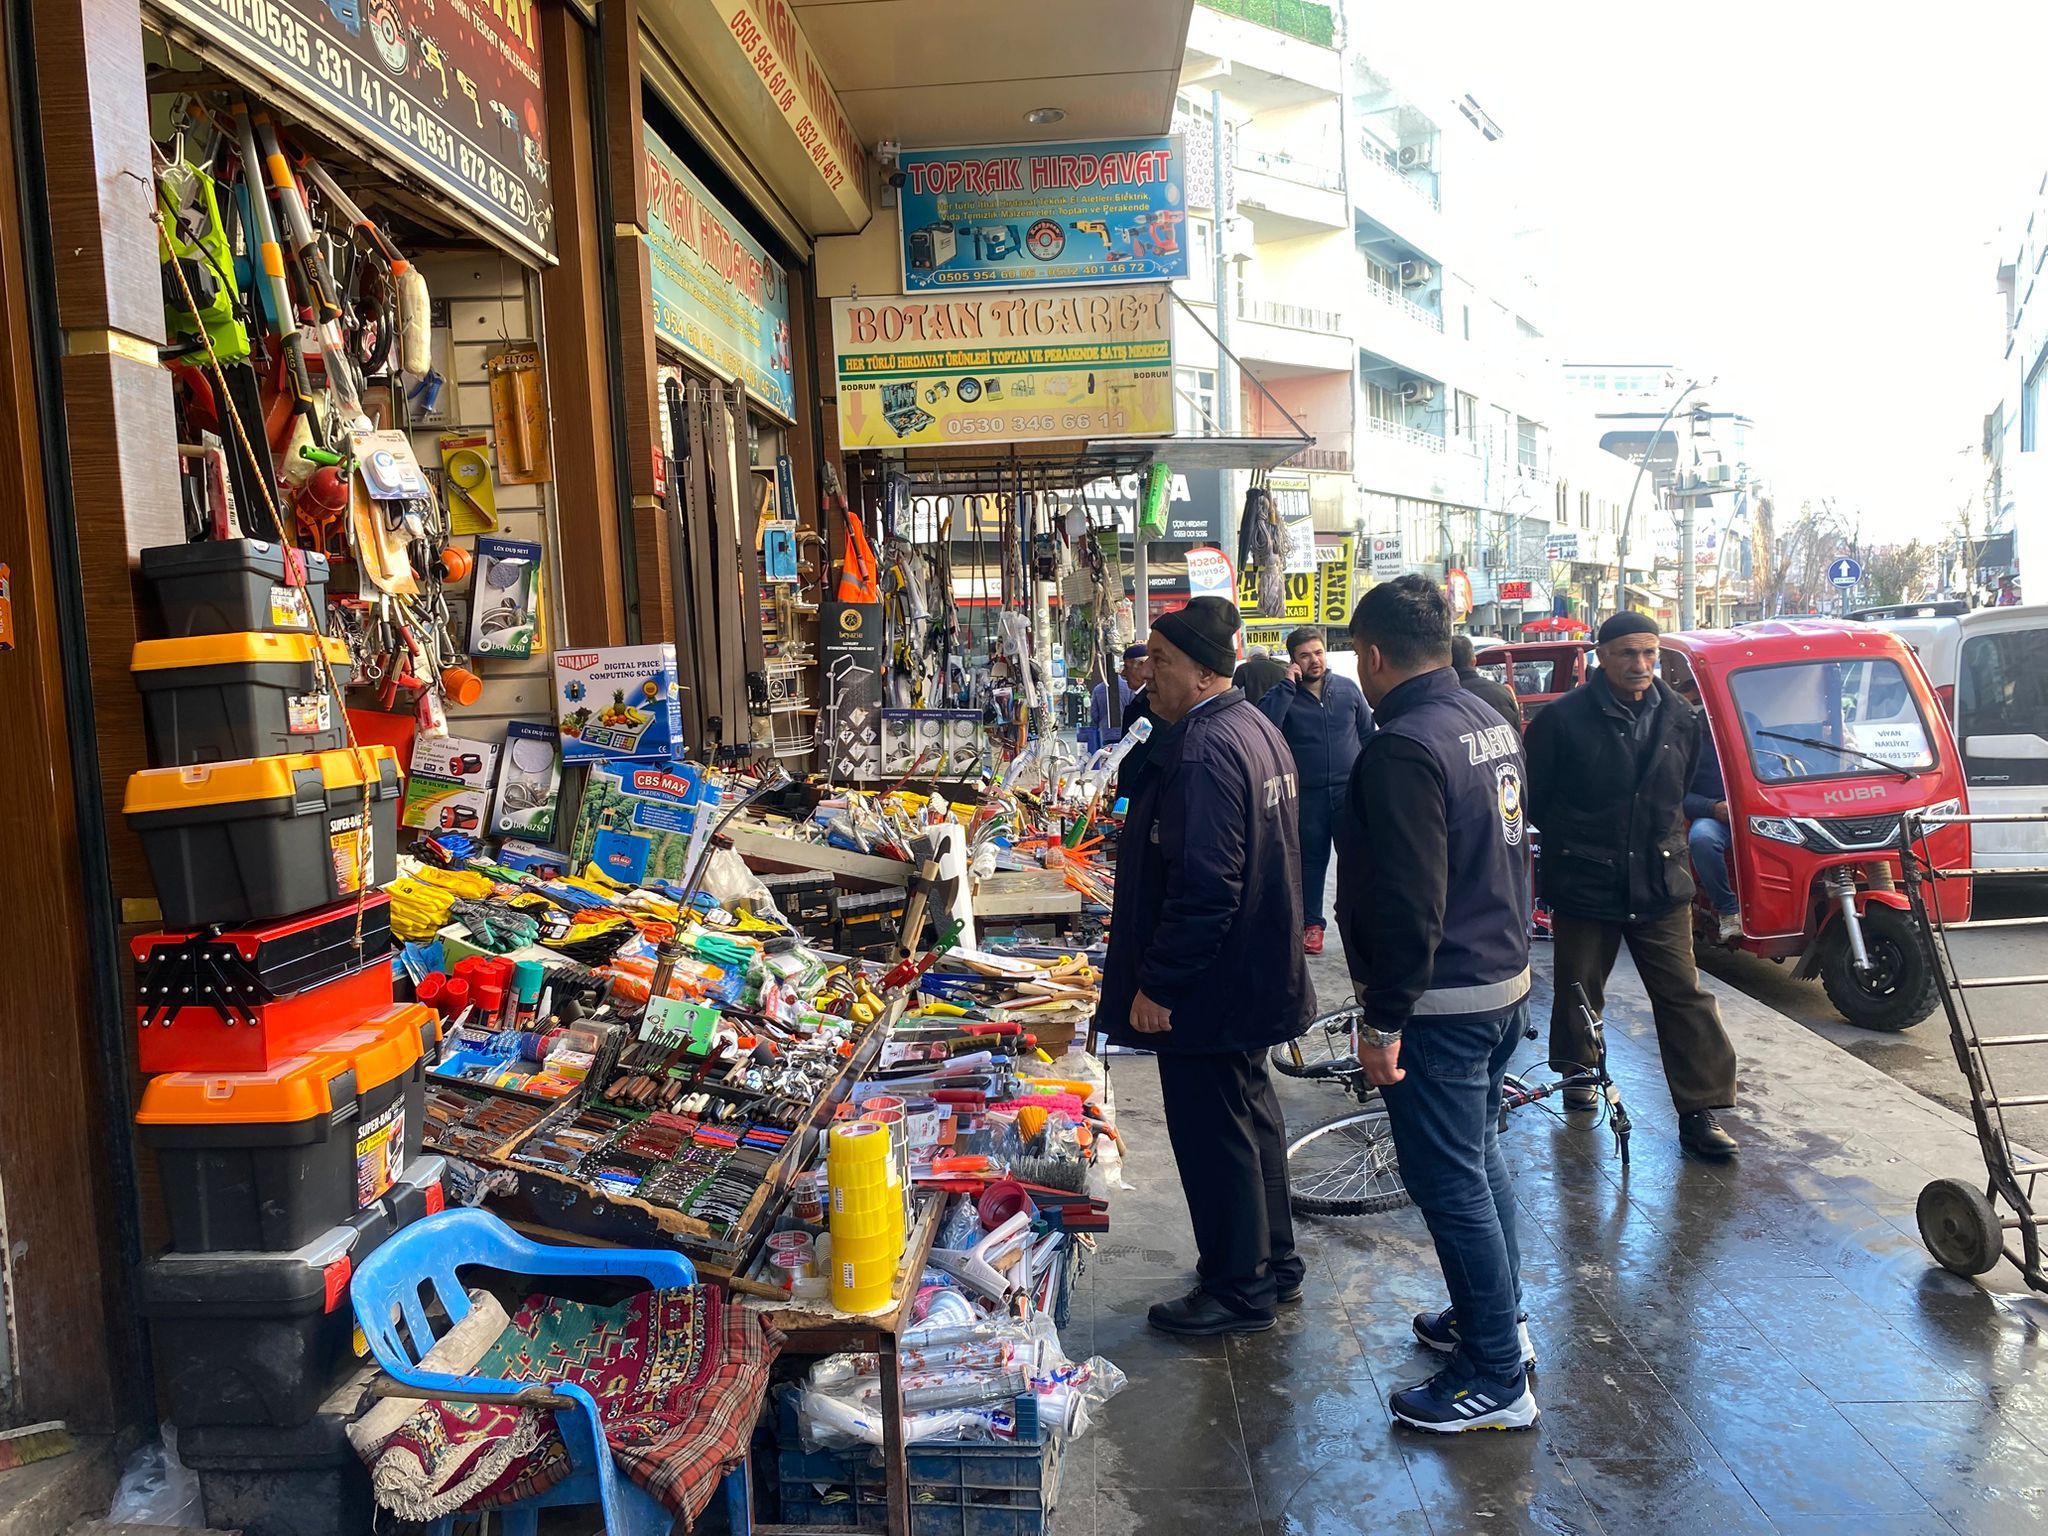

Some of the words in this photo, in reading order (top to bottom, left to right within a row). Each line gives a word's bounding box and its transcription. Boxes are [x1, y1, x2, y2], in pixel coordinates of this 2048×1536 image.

[730, 9, 762, 53] 0505
[753, 45, 777, 79] 954
[769, 72, 786, 96] 60
[779, 88, 796, 113] 06
[315, 38, 354, 98] 331
[360, 69, 383, 118] 41
[459, 143, 487, 191] 872
[489, 166, 507, 204] 83
[509, 180, 525, 218] 25
[795, 115, 818, 150] 0532
[812, 142, 828, 167] 401
[822, 160, 837, 179] 46
[907, 155, 1024, 197] TOPRAK
[1030, 150, 1172, 195] HIRDAVAT
[829, 170, 844, 191] 72
[644, 146, 698, 256] PRAK
[1058, 206, 1088, 216] Toptan
[1090, 206, 1101, 214] ve
[1103, 203, 1151, 214] Perakende
[938, 272, 969, 282] 0505
[973, 271, 996, 281] 954
[1000, 270, 1016, 279] 60
[1082, 265, 1105, 275] 401
[1109, 263, 1126, 273] 46
[1129, 262, 1145, 272] 72
[664, 306, 686, 340] 954
[686, 321, 701, 351] 60
[847, 301, 985, 345] BOTAN
[991, 292, 1165, 339] TİCARET
[504, 354, 534, 365] ELTOS
[845, 358, 865, 372] HER
[866, 354, 896, 371] TÜRLÜ
[897, 355, 944, 370] HIRDAVAT
[945, 350, 991, 367] ÜRÜNLERİ
[992, 348, 1029, 365] TOPTAN
[1030, 348, 1044, 364] VE
[1044, 346, 1099, 363] PERAKENDE
[1100, 345, 1127, 362] SATIŞ
[1128, 341, 1169, 359] MERKEZİ
[1133, 370, 1169, 380] BODRUM
[841, 382, 876, 392] BODRUM
[947, 414, 1004, 434] 0530
[1012, 413, 1055, 432] 346
[1065, 412, 1090, 430] 66
[1098, 411, 1125, 429] 11
[558, 654, 598, 671] DINAMIC
[604, 661, 636, 671] DIGITAL
[637, 660, 660, 668] PRICE
[589, 671, 635, 681] COMPUTING
[1459, 724, 1520, 765] ZABIT
[1874, 740, 1910, 748] NAKLİYAT
[1903, 751, 1920, 759] 5755
[412, 778, 428, 786] GOLD
[428, 781, 449, 789] SILVER
[637, 775, 660, 786] CBS
[661, 778, 686, 794] MAX
[1823, 785, 1887, 804] KUBA
[357, 1108, 392, 1140] SUPER-BAG
[358, 1140, 368, 1156] 22
